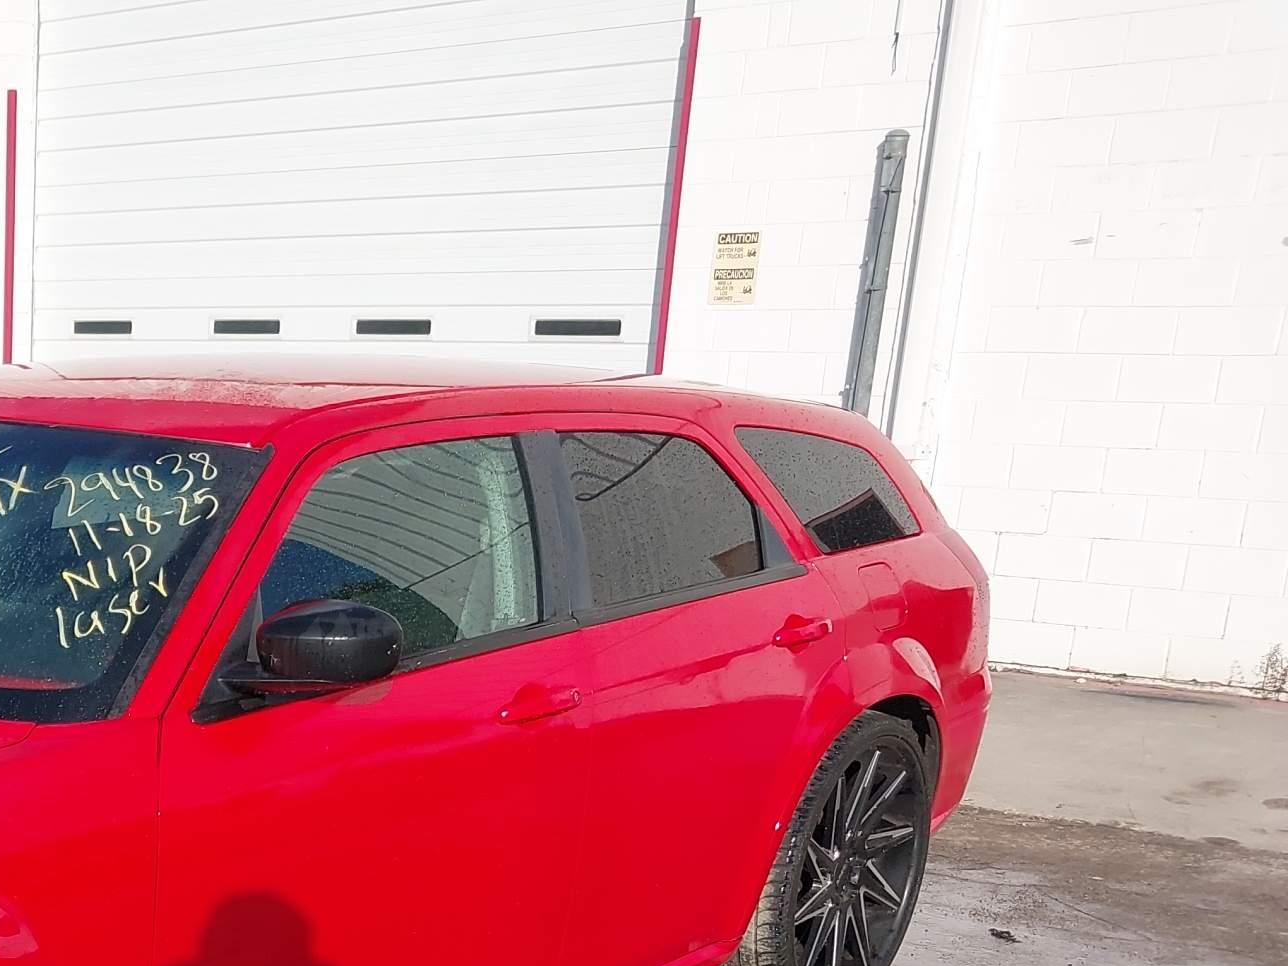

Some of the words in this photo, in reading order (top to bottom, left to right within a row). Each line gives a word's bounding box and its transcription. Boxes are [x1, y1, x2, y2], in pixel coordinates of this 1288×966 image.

[719, 233, 758, 243] CAUTION
[44, 451, 219, 517] 294838
[68, 487, 219, 557] 11-18-25
